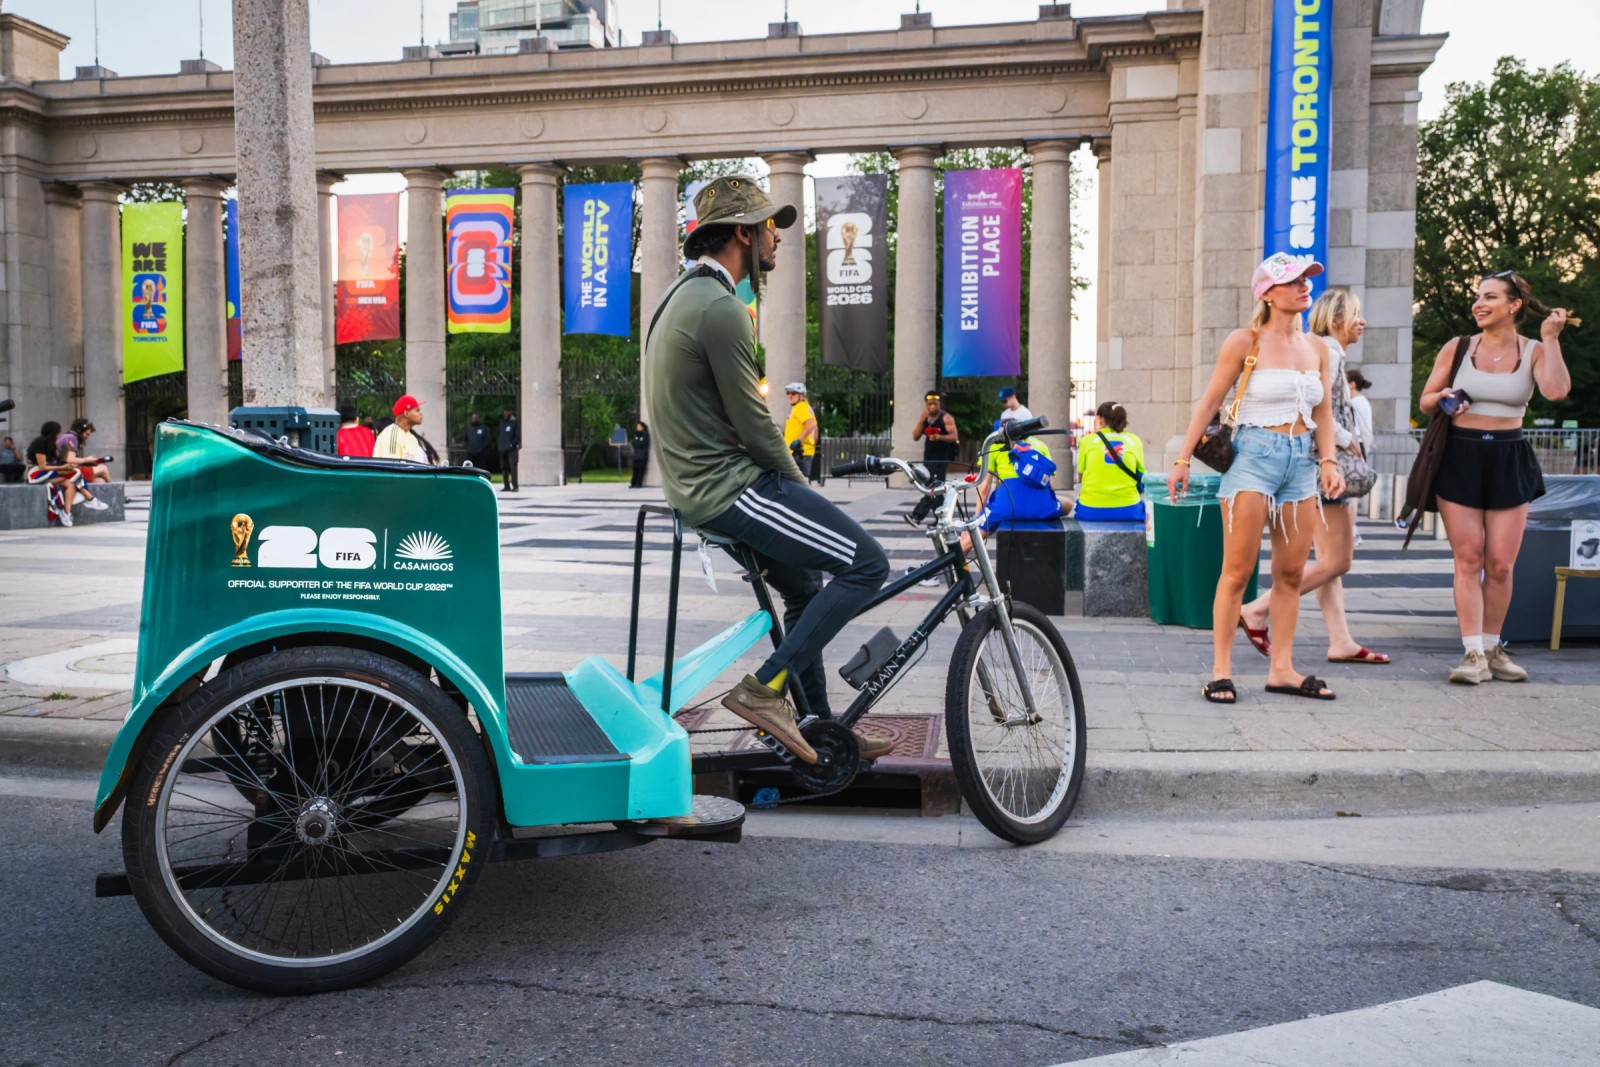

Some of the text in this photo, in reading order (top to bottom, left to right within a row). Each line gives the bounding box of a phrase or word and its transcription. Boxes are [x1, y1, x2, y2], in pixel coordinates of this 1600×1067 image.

[1291, 0, 1320, 171] TORONTO
[1289, 176, 1316, 249] ARE
[132, 242, 166, 258] WE
[581, 199, 595, 308] THE WORLD
[594, 200, 610, 308] IN A CITY
[982, 214, 1000, 276] PLACE
[132, 260, 166, 272] ARE
[961, 216, 980, 330] EXHIBITION
[355, 280, 375, 288] FIFA
[827, 286, 855, 294] WORLD
[827, 293, 873, 305] 2026
[336, 552, 361, 561] FIFA
[394, 562, 454, 571] CASAMIGOS
[228, 580, 266, 588] OFFICIAL
[268, 580, 320, 588] SUPPORTER
[322, 581, 334, 589] OF
[373, 582, 404, 590] WORLD
[868, 660, 899, 695] MAIN
[434, 830, 476, 915] MAXXIS
